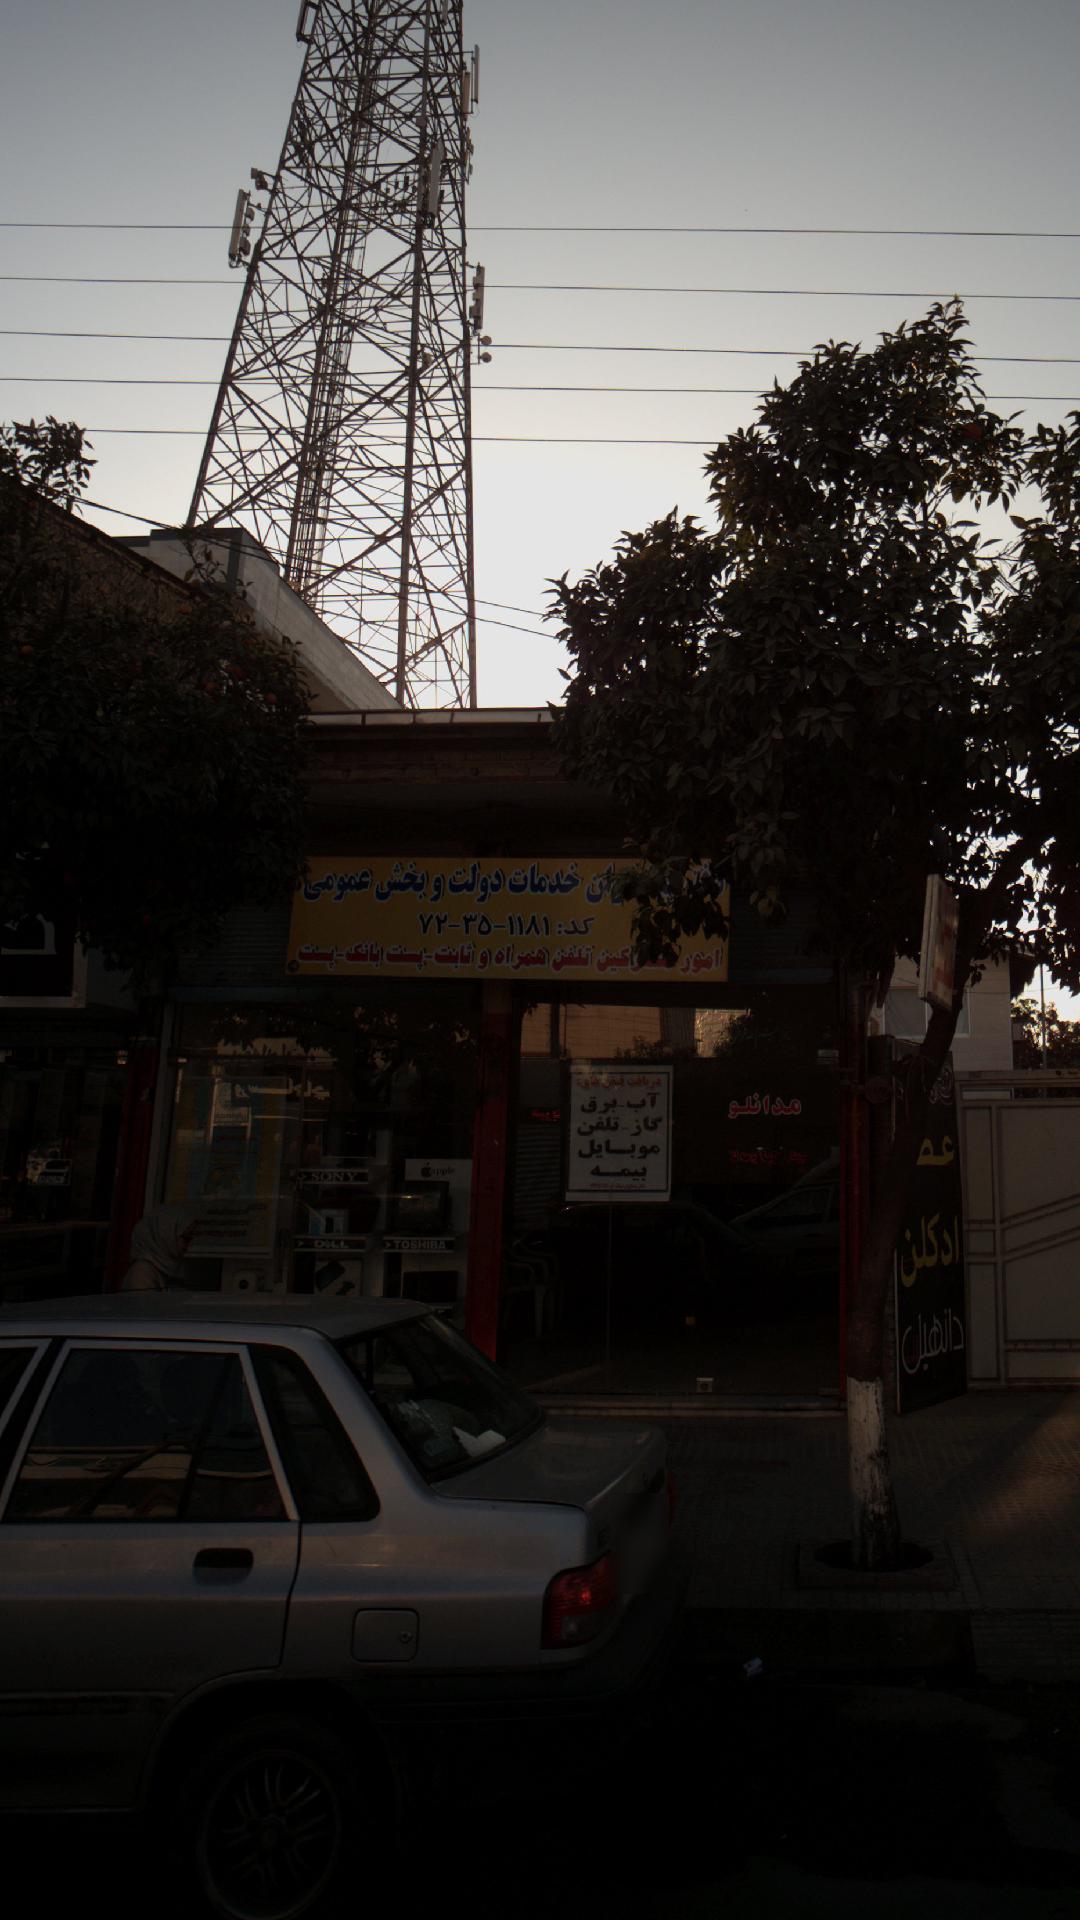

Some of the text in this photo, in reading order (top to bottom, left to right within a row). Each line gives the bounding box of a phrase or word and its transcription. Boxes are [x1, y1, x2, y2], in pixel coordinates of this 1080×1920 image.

[303, 868, 373, 901] عمومی
[375, 863, 428, 901] بخش
[430, 873, 445, 902] و
[448, 863, 505, 902] دولت
[508, 862, 581, 894] خدمات
[478, 950, 492, 970] و
[494, 944, 549, 970] همراه
[552, 945, 595, 971] تلفن
[681, 946, 723, 973] امور
[727, 1091, 802, 1119] مدانلو
[578, 1139, 661, 1159] موبایل
[311, 1172, 358, 1182] SONY
[590, 1165, 648, 1182] بیمه
[314, 1240, 350, 1249] DELL
[393, 1240, 448, 1249] TOSHIBA
[900, 1211, 960, 1288] ادکلن
